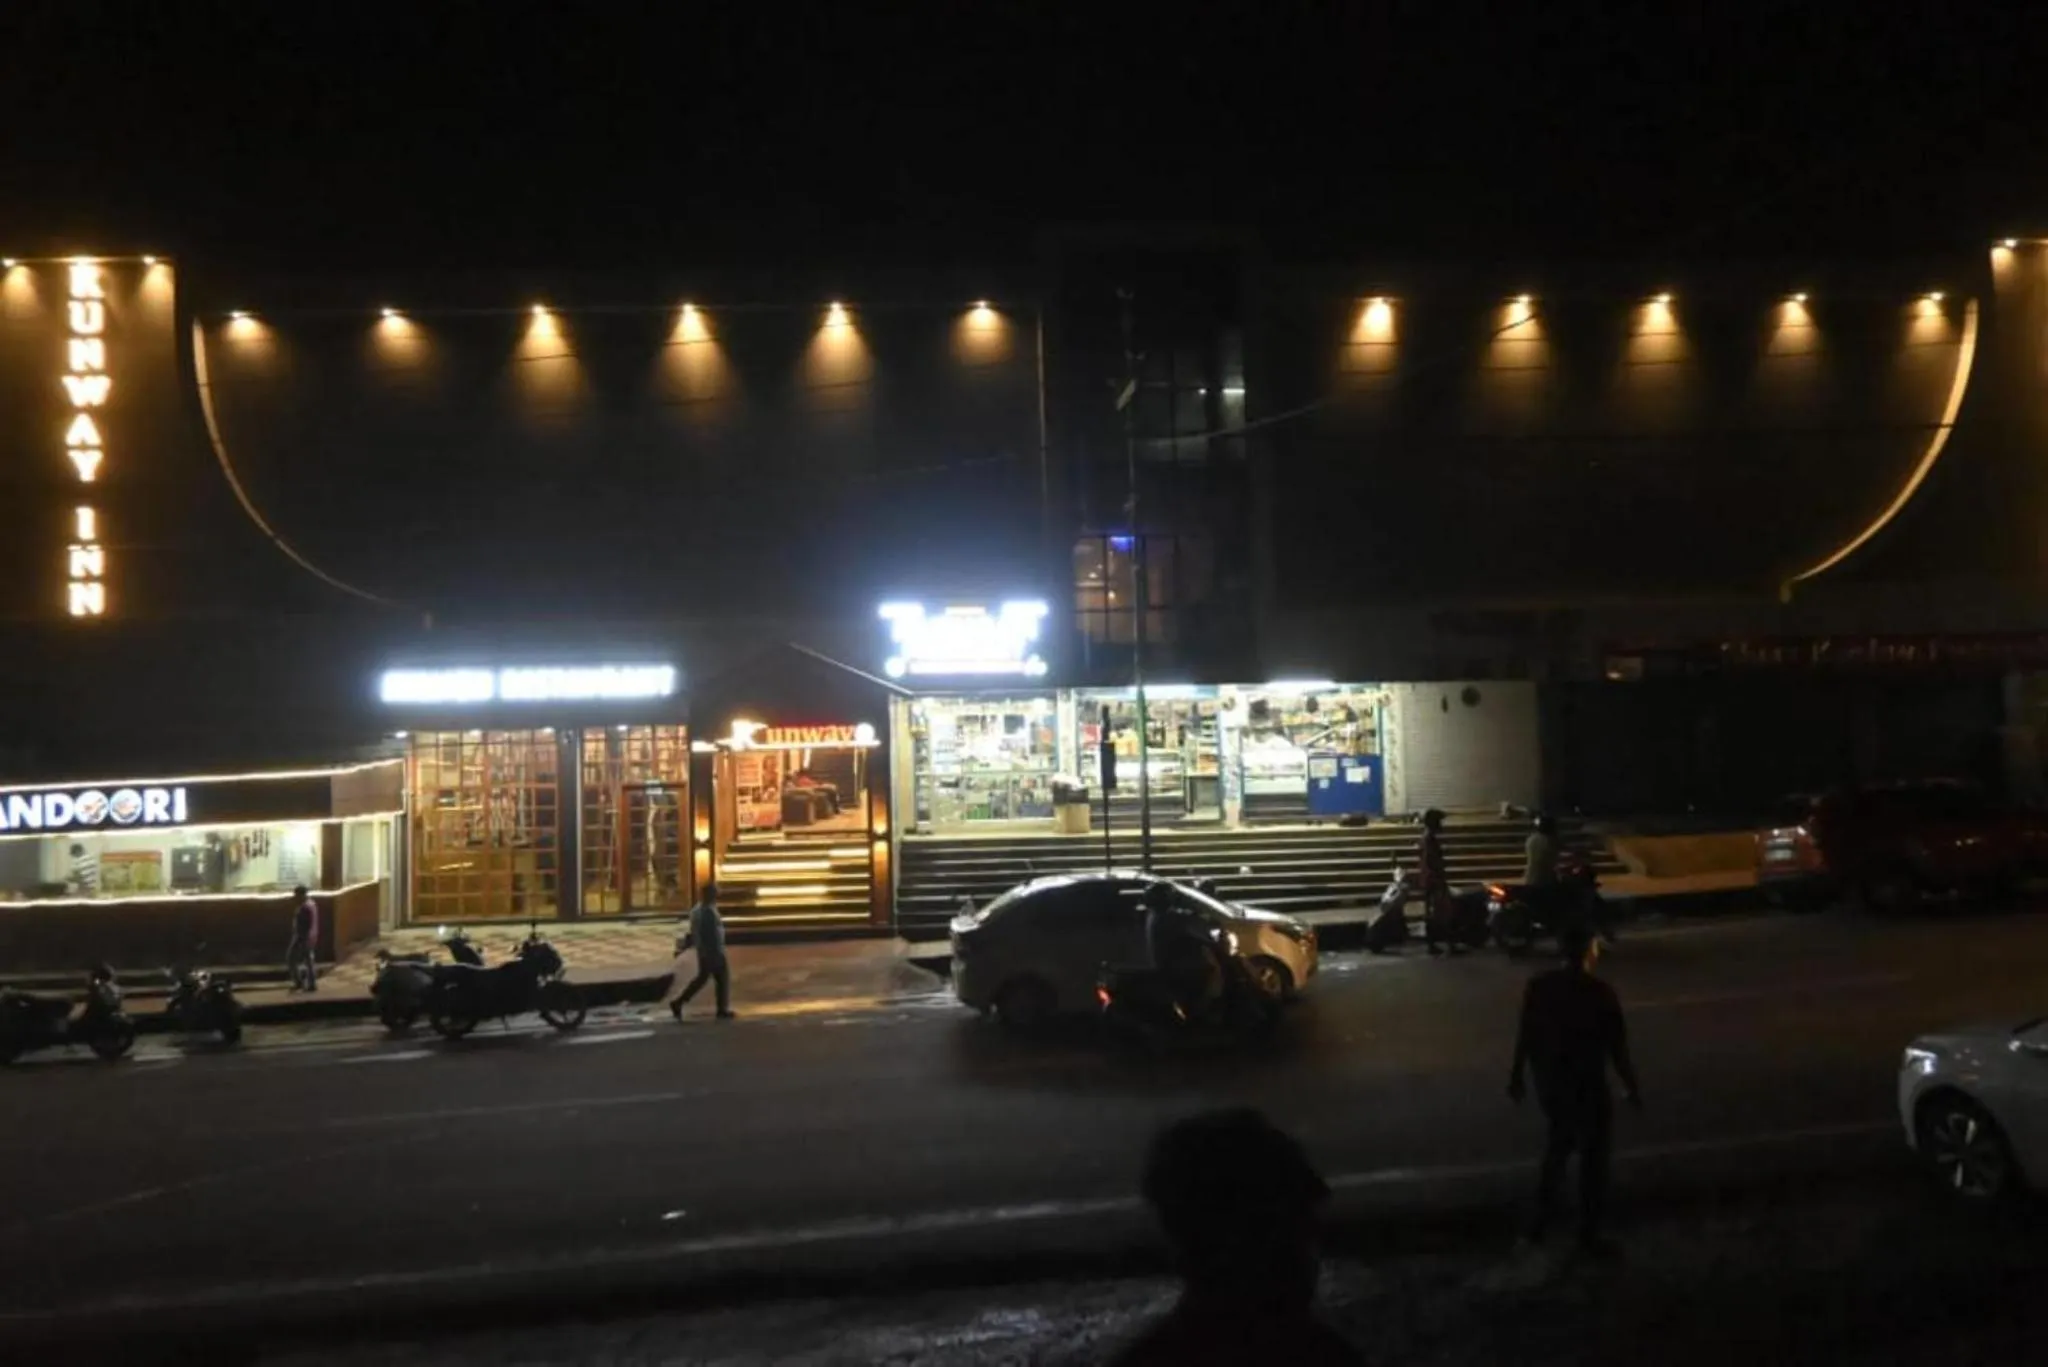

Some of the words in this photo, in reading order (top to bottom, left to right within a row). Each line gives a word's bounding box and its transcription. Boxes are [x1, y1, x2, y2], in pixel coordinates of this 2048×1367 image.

[62, 262, 111, 482] RUNWAY
[68, 507, 105, 616] INN
[0, 787, 188, 829] NDOORI
